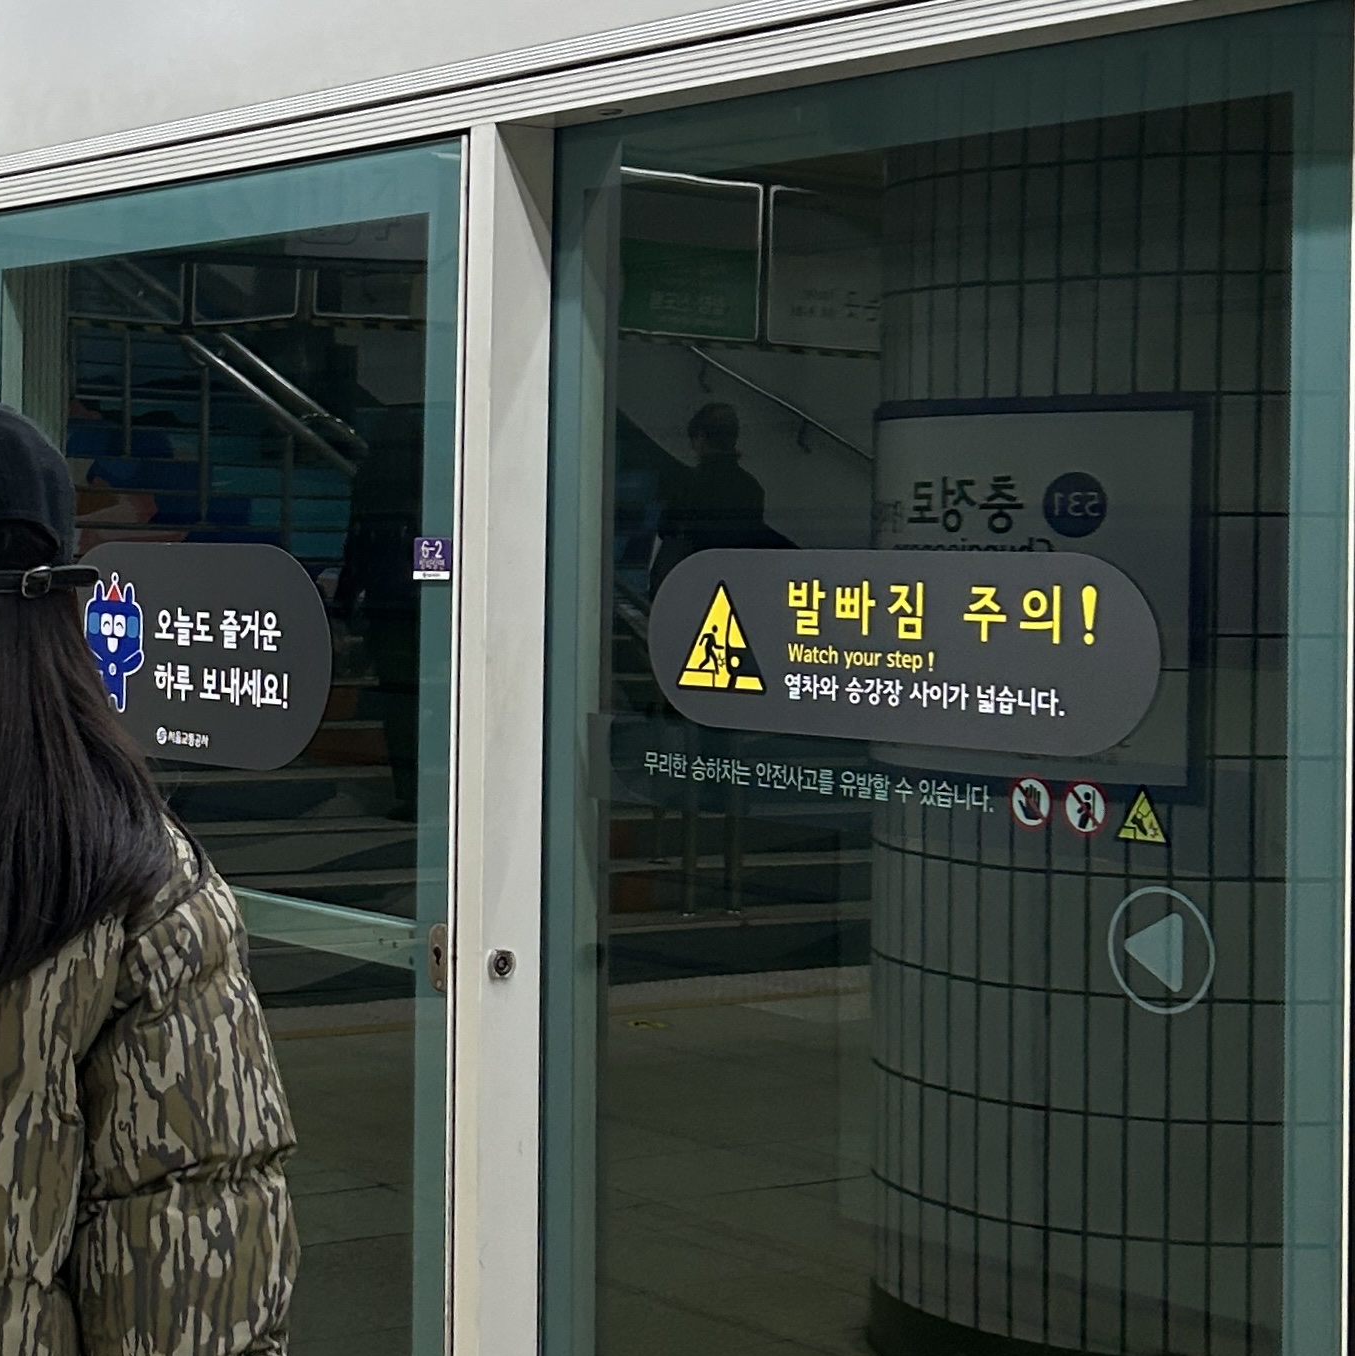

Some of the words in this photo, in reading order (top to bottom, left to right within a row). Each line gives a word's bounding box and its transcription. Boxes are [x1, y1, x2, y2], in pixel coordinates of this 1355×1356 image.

[421, 540, 443, 559] 6-2
[154, 607, 214, 646] 오늘도
[219, 610, 282, 652] 즐거운
[787, 579, 925, 640] 발빠짐
[963, 585, 1098, 645] 주의!
[788, 642, 839, 665] Watch
[843, 649, 882, 669] your
[154, 662, 194, 702] 하루
[199, 667, 289, 709] 보내세요!
[784, 673, 839, 701] 열차와
[844, 677, 903, 707] 승강장
[909, 681, 969, 710] 사이가
[976, 685, 1066, 717] 넓습니다.
[644, 751, 688, 779] 무리한
[691, 755, 752, 786] 승하차는
[755, 762, 835, 795] 안전사고를
[840, 771, 891, 802] 유발할
[894, 777, 914, 804] 수
[918, 779, 995, 813] 있습니다.
